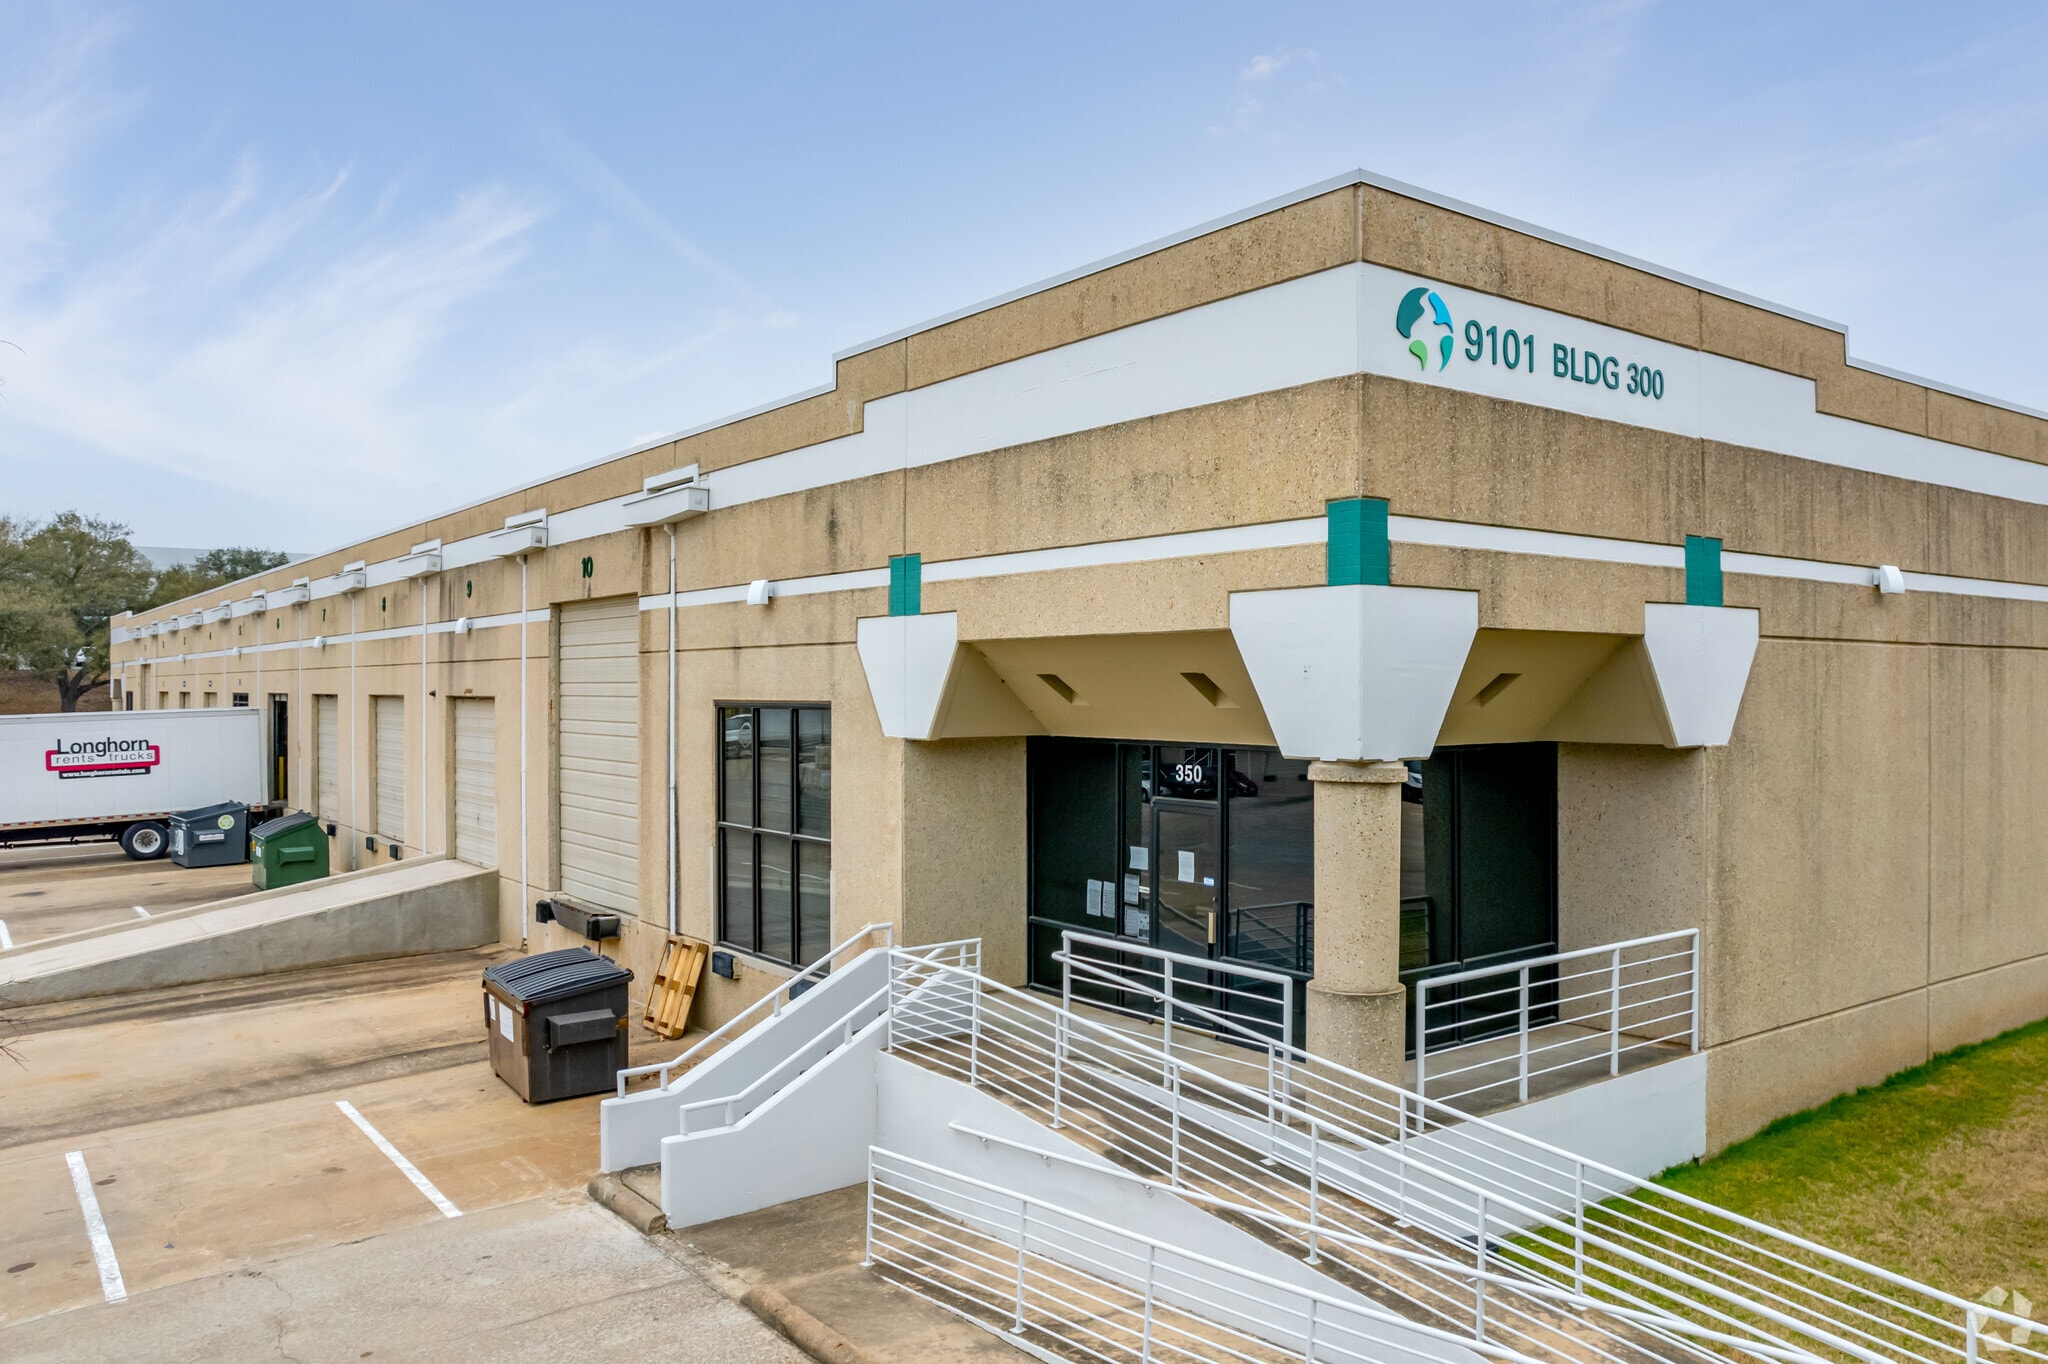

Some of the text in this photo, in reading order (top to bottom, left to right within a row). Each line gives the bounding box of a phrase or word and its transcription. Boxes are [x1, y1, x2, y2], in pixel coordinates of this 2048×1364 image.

[1464, 319, 1665, 400] 9101 BLDG 300
[581, 556, 594, 578] 10
[466, 580, 472, 598] 9
[57, 737, 149, 757] Longhorn
[56, 751, 154, 764] rents trucks
[1175, 763, 1202, 783] 350
